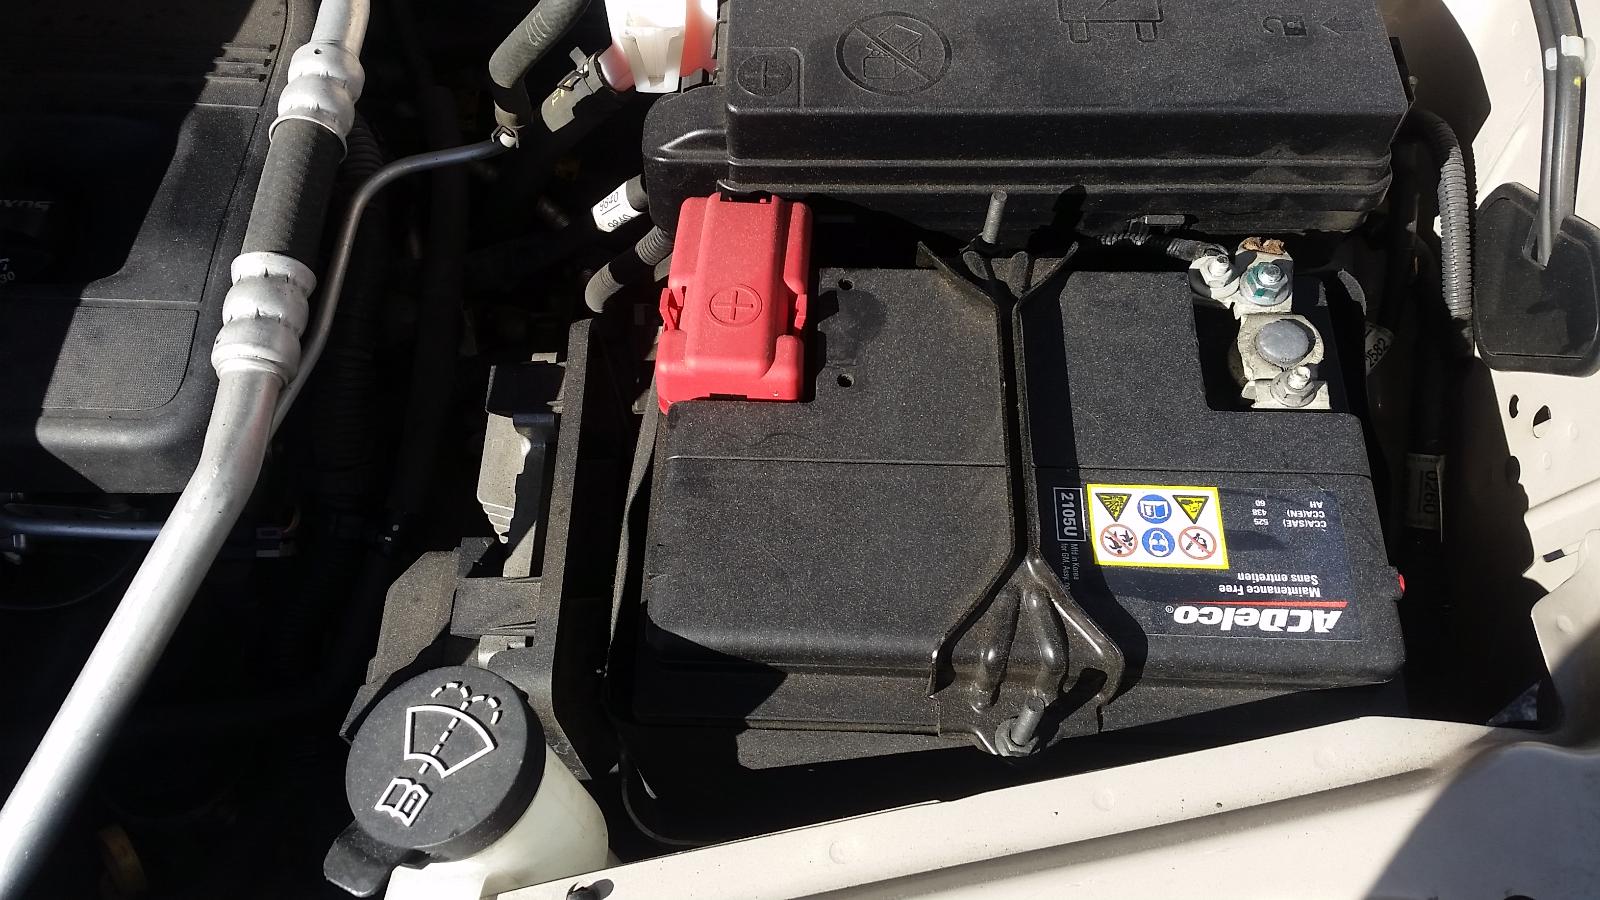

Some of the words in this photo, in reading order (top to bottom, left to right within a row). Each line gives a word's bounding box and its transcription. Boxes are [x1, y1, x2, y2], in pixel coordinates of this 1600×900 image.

[1309, 501, 1323, 509] AH
[1060, 492, 1078, 537] 2105U
[1287, 509, 1325, 518] CCA(EN)
[1283, 519, 1327, 528] CCA(SAE)
[1238, 572, 1288, 584] entretien
[1291, 574, 1318, 585] Sans
[1219, 584, 1244, 596] Free
[1247, 585, 1321, 598] Maintenance
